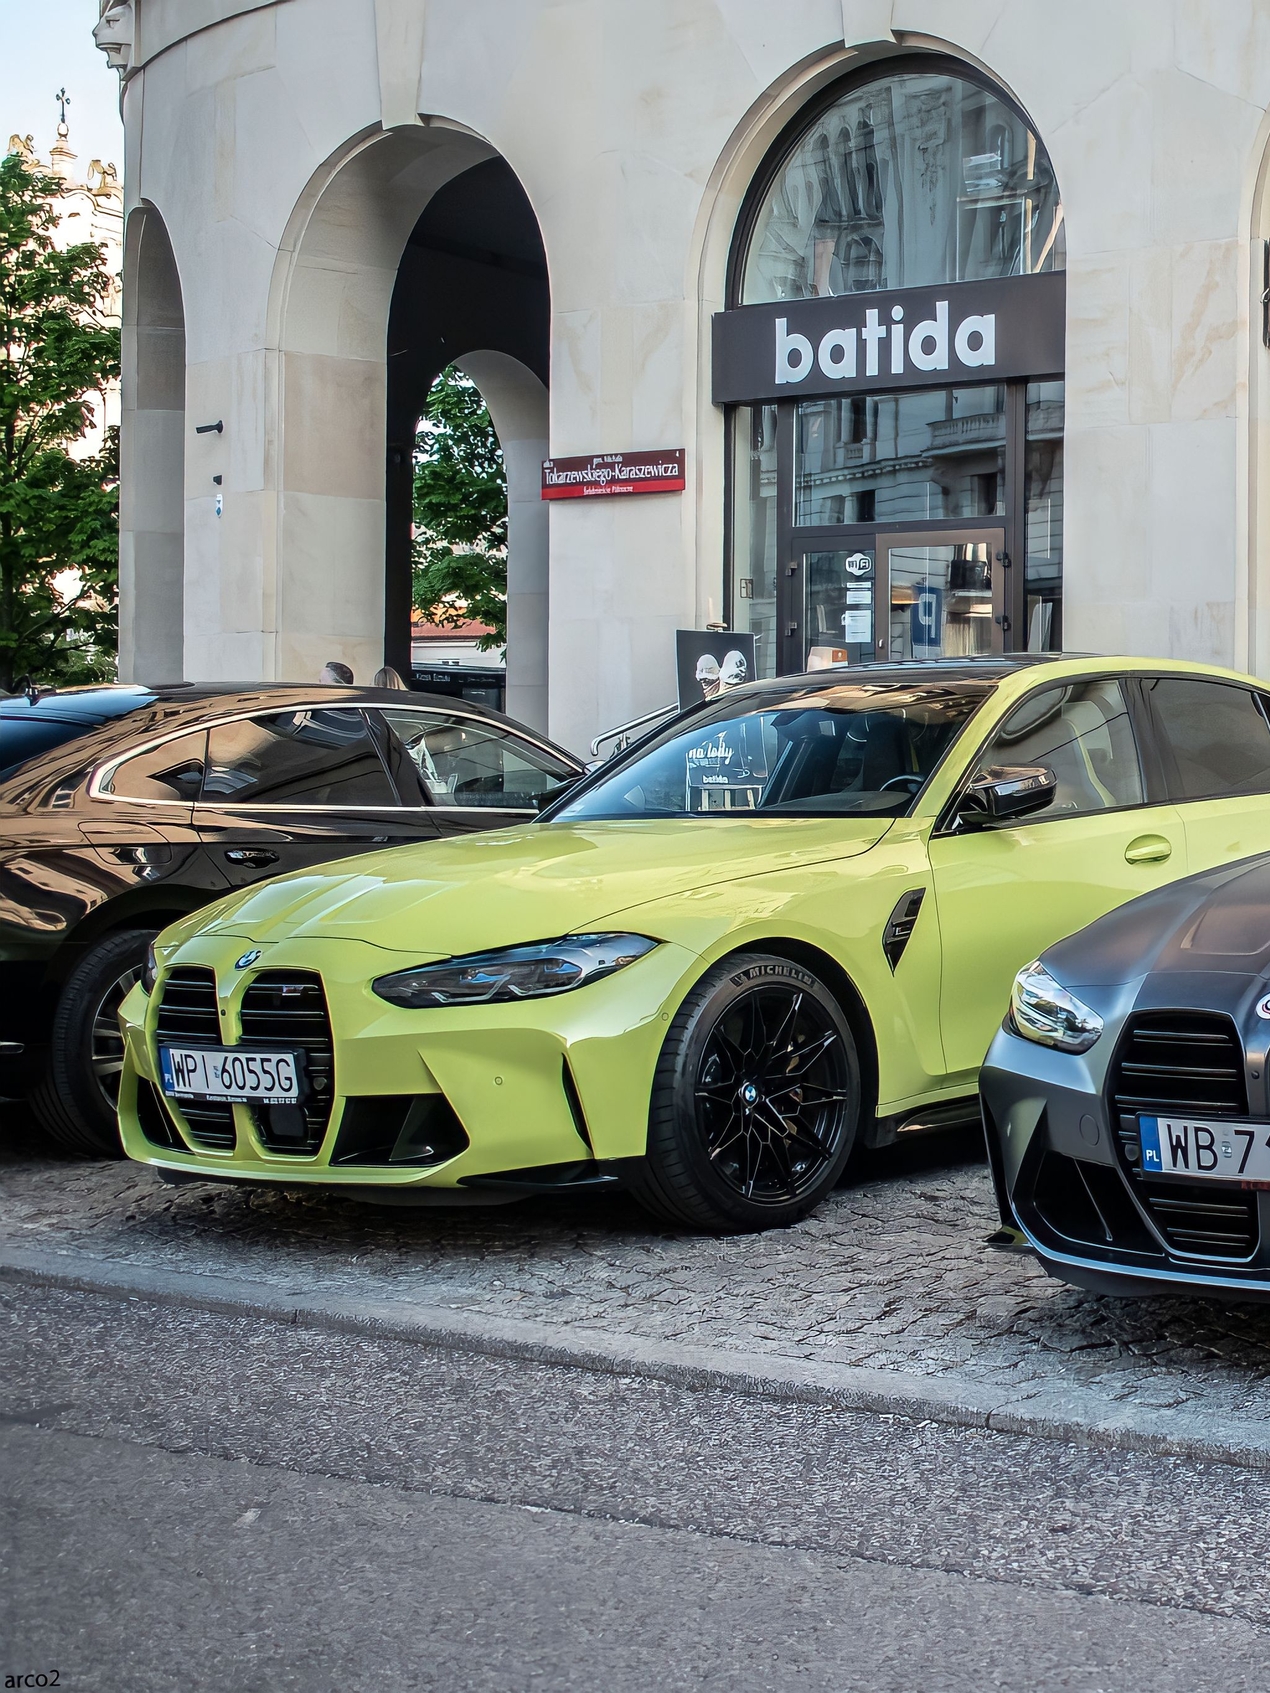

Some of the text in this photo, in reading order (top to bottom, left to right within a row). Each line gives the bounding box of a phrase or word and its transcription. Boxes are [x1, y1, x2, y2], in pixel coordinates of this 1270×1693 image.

[775, 300, 996, 385] batida
[750, 965, 813, 985] MICHELIN
[221, 1056, 294, 1093] 6055G
[1146, 1150, 1160, 1162] PL
[1166, 1124, 1218, 1171] WB
